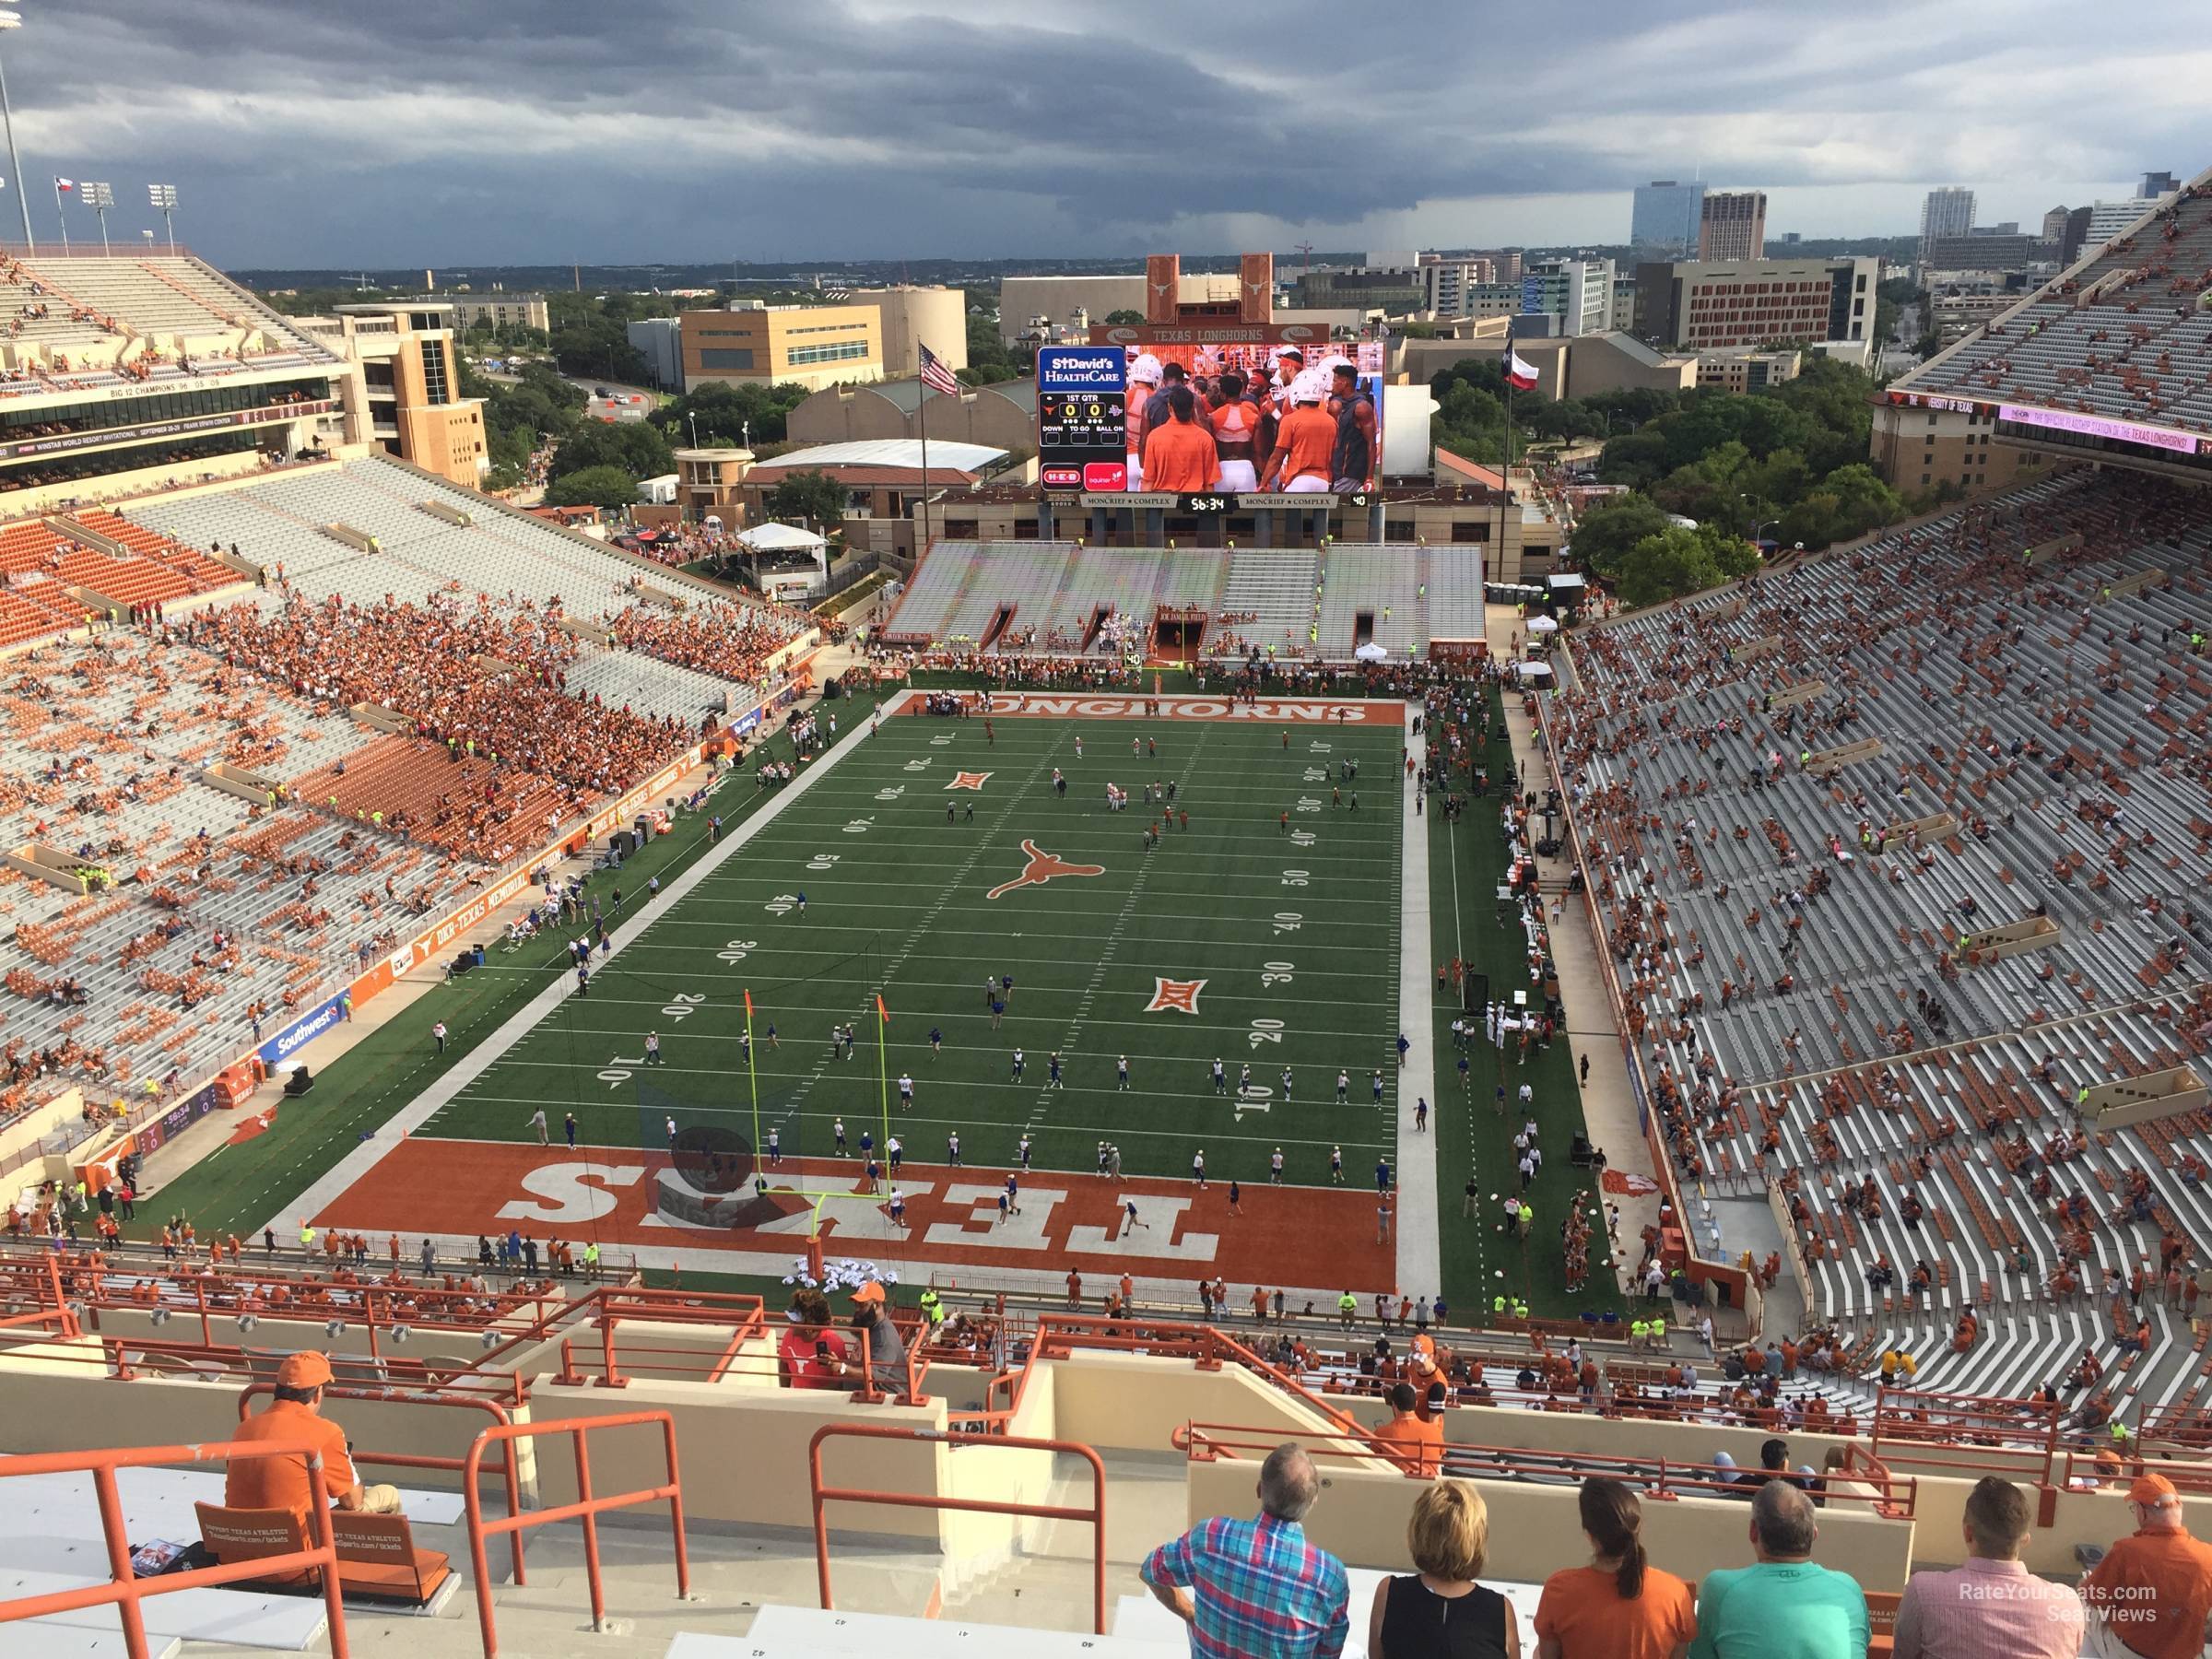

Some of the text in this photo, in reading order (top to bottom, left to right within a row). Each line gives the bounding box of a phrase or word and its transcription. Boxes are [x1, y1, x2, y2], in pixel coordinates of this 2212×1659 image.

[1153, 329, 1264, 342] TEXAS LONGHORNS
[111, 389, 123, 398] BIG
[125, 388, 133, 396] 12
[135, 384, 176, 395] CHAMPIONS
[241, 401, 326, 424] WELOME TO
[1065, 404, 1076, 417] 0
[1089, 404, 1100, 417] 0
[1909, 394, 1918, 406] THE
[1948, 399, 1956, 411] OF
[1957, 401, 1973, 414] TEXAS
[37, 441, 62, 452] WINSTAR
[62, 438, 82, 447] WORLD
[83, 435, 102, 444] RESORT
[103, 430, 137, 441] INVITATIONAL
[140, 427, 167, 436] SEPTEMBER
[2132, 428, 2150, 441] TEXAS
[1191, 498, 1225, 511] 56:34
[1352, 496, 1366, 506] 40
[1126, 653, 1140, 665] 40
[968, 699, 1367, 722] ONGHORNS
[903, 759, 931, 771] 20
[1303, 769, 1327, 782] 20
[874, 786, 904, 801] 30
[1296, 798, 1323, 813] 30
[842, 818, 872, 833] 40
[1290, 831, 1317, 848] 40
[806, 853, 841, 870] 50
[1281, 869, 1311, 887] 50
[436, 900, 487, 946] DKR-TEXAS
[487, 872, 529, 911] MEMORIAL
[764, 893, 799, 912] 40
[1272, 912, 1303, 931] 40
[716, 939, 758, 960] 30
[1261, 961, 1295, 982] 30
[661, 993, 707, 1017] 20
[277, 1009, 331, 1055] Southwest
[1248, 1018, 1286, 1043] 20
[597, 1056, 645, 1081] 10
[233, 1085, 253, 1106] TEXAS
[1233, 1085, 1274, 1113] 10
[150, 1137, 159, 1149] 0
[494, 1161, 1220, 1262] TEXAS
